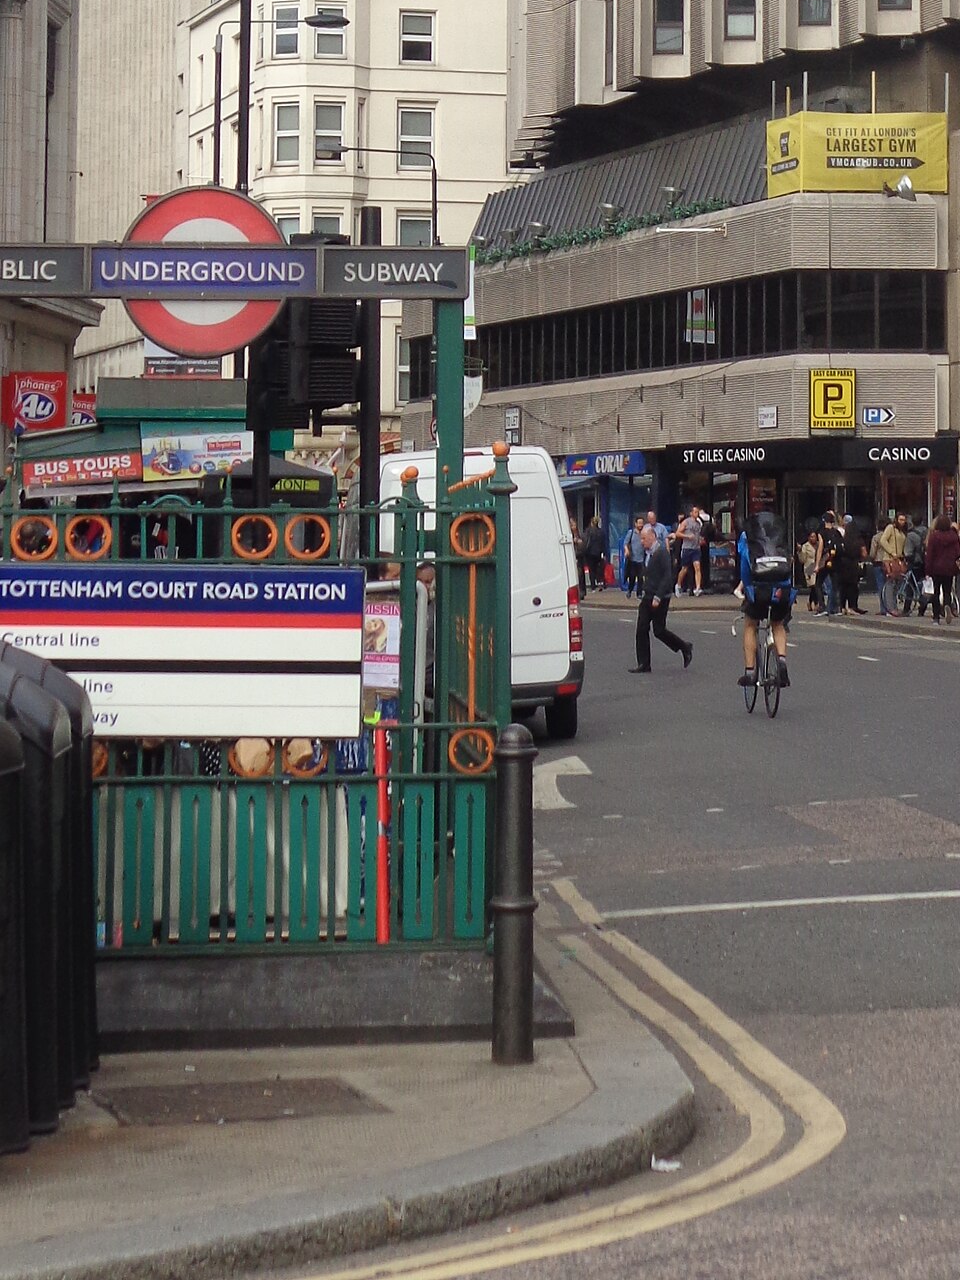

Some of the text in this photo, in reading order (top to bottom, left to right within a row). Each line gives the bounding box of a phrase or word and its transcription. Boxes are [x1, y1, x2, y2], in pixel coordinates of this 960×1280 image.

[826, 127, 917, 137] GET FIT AT LONDON'S
[826, 138, 917, 153] LARGEST GYM
[101, 260, 305, 282] UNDERGROUND
[344, 262, 443, 282] SUBWAY
[20, 378, 57, 392] phones
[823, 383, 843, 414] P
[683, 447, 765, 463] ST GILES CASINO
[868, 447, 931, 461] CASINO
[34, 455, 132, 476] BUS TOURS
[595, 454, 625, 474] CORAL
[0, 579, 346, 601] TOTTENHAM COURT ROAD STATION
[2, 632, 100, 647] Central line
[83, 679, 113, 693] line
